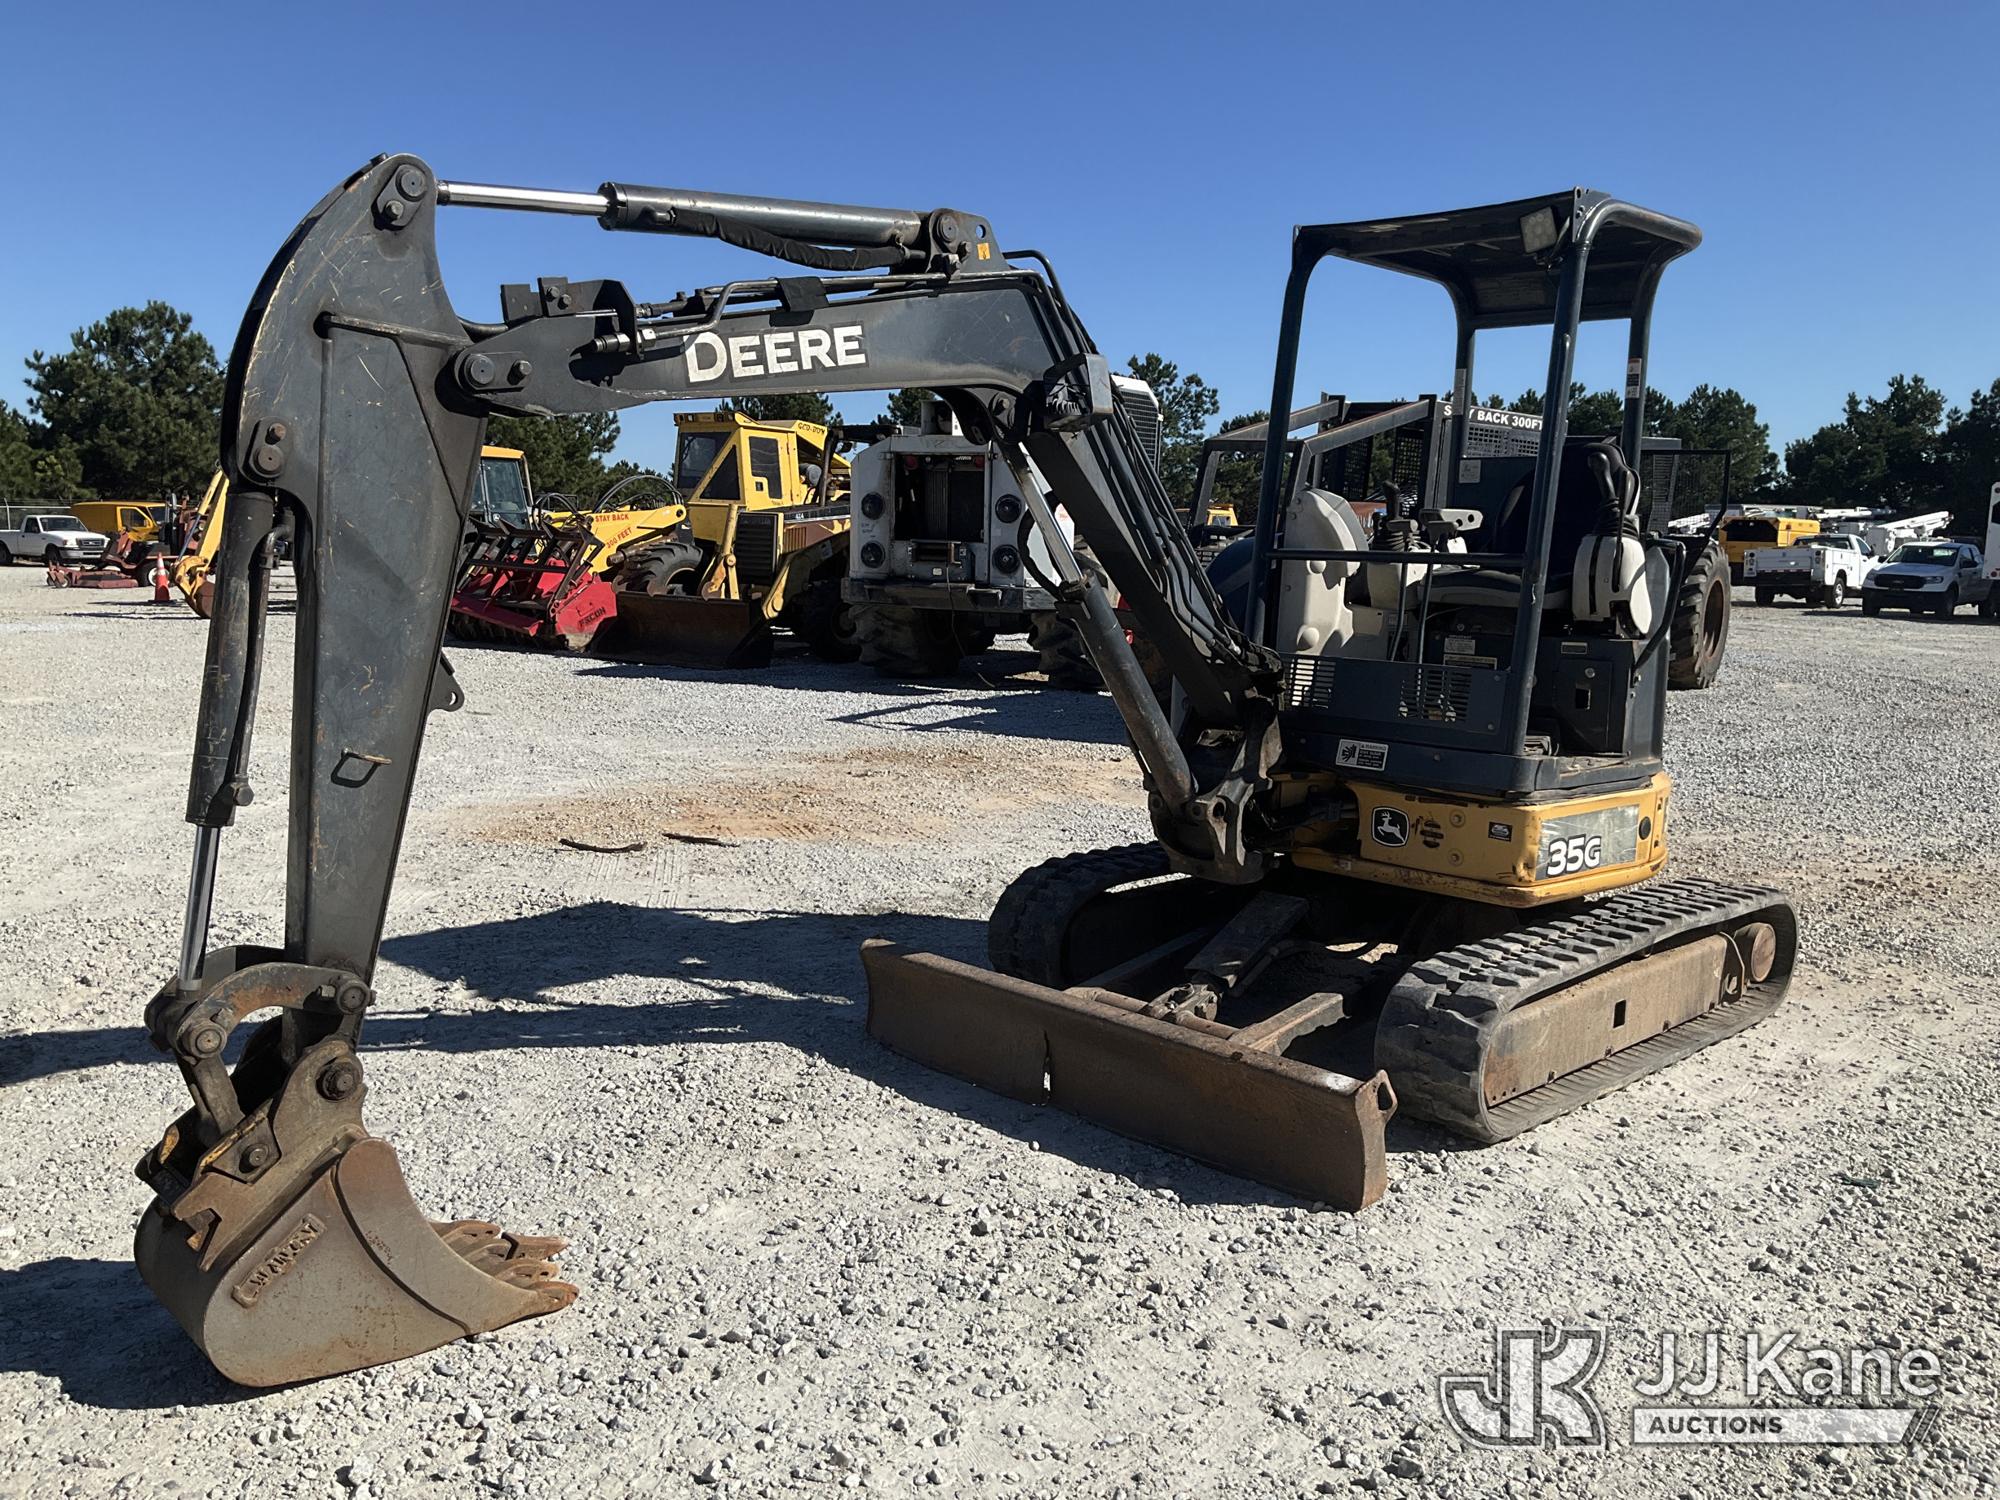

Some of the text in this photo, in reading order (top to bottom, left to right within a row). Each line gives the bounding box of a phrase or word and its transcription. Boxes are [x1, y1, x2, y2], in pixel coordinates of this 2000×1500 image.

[683, 325, 866, 383] DEERE
[1477, 410, 1510, 425] BACK
[594, 513, 629, 523] STAY BACK
[617, 527, 633, 541] FEET
[1546, 834, 1602, 877] 35G
